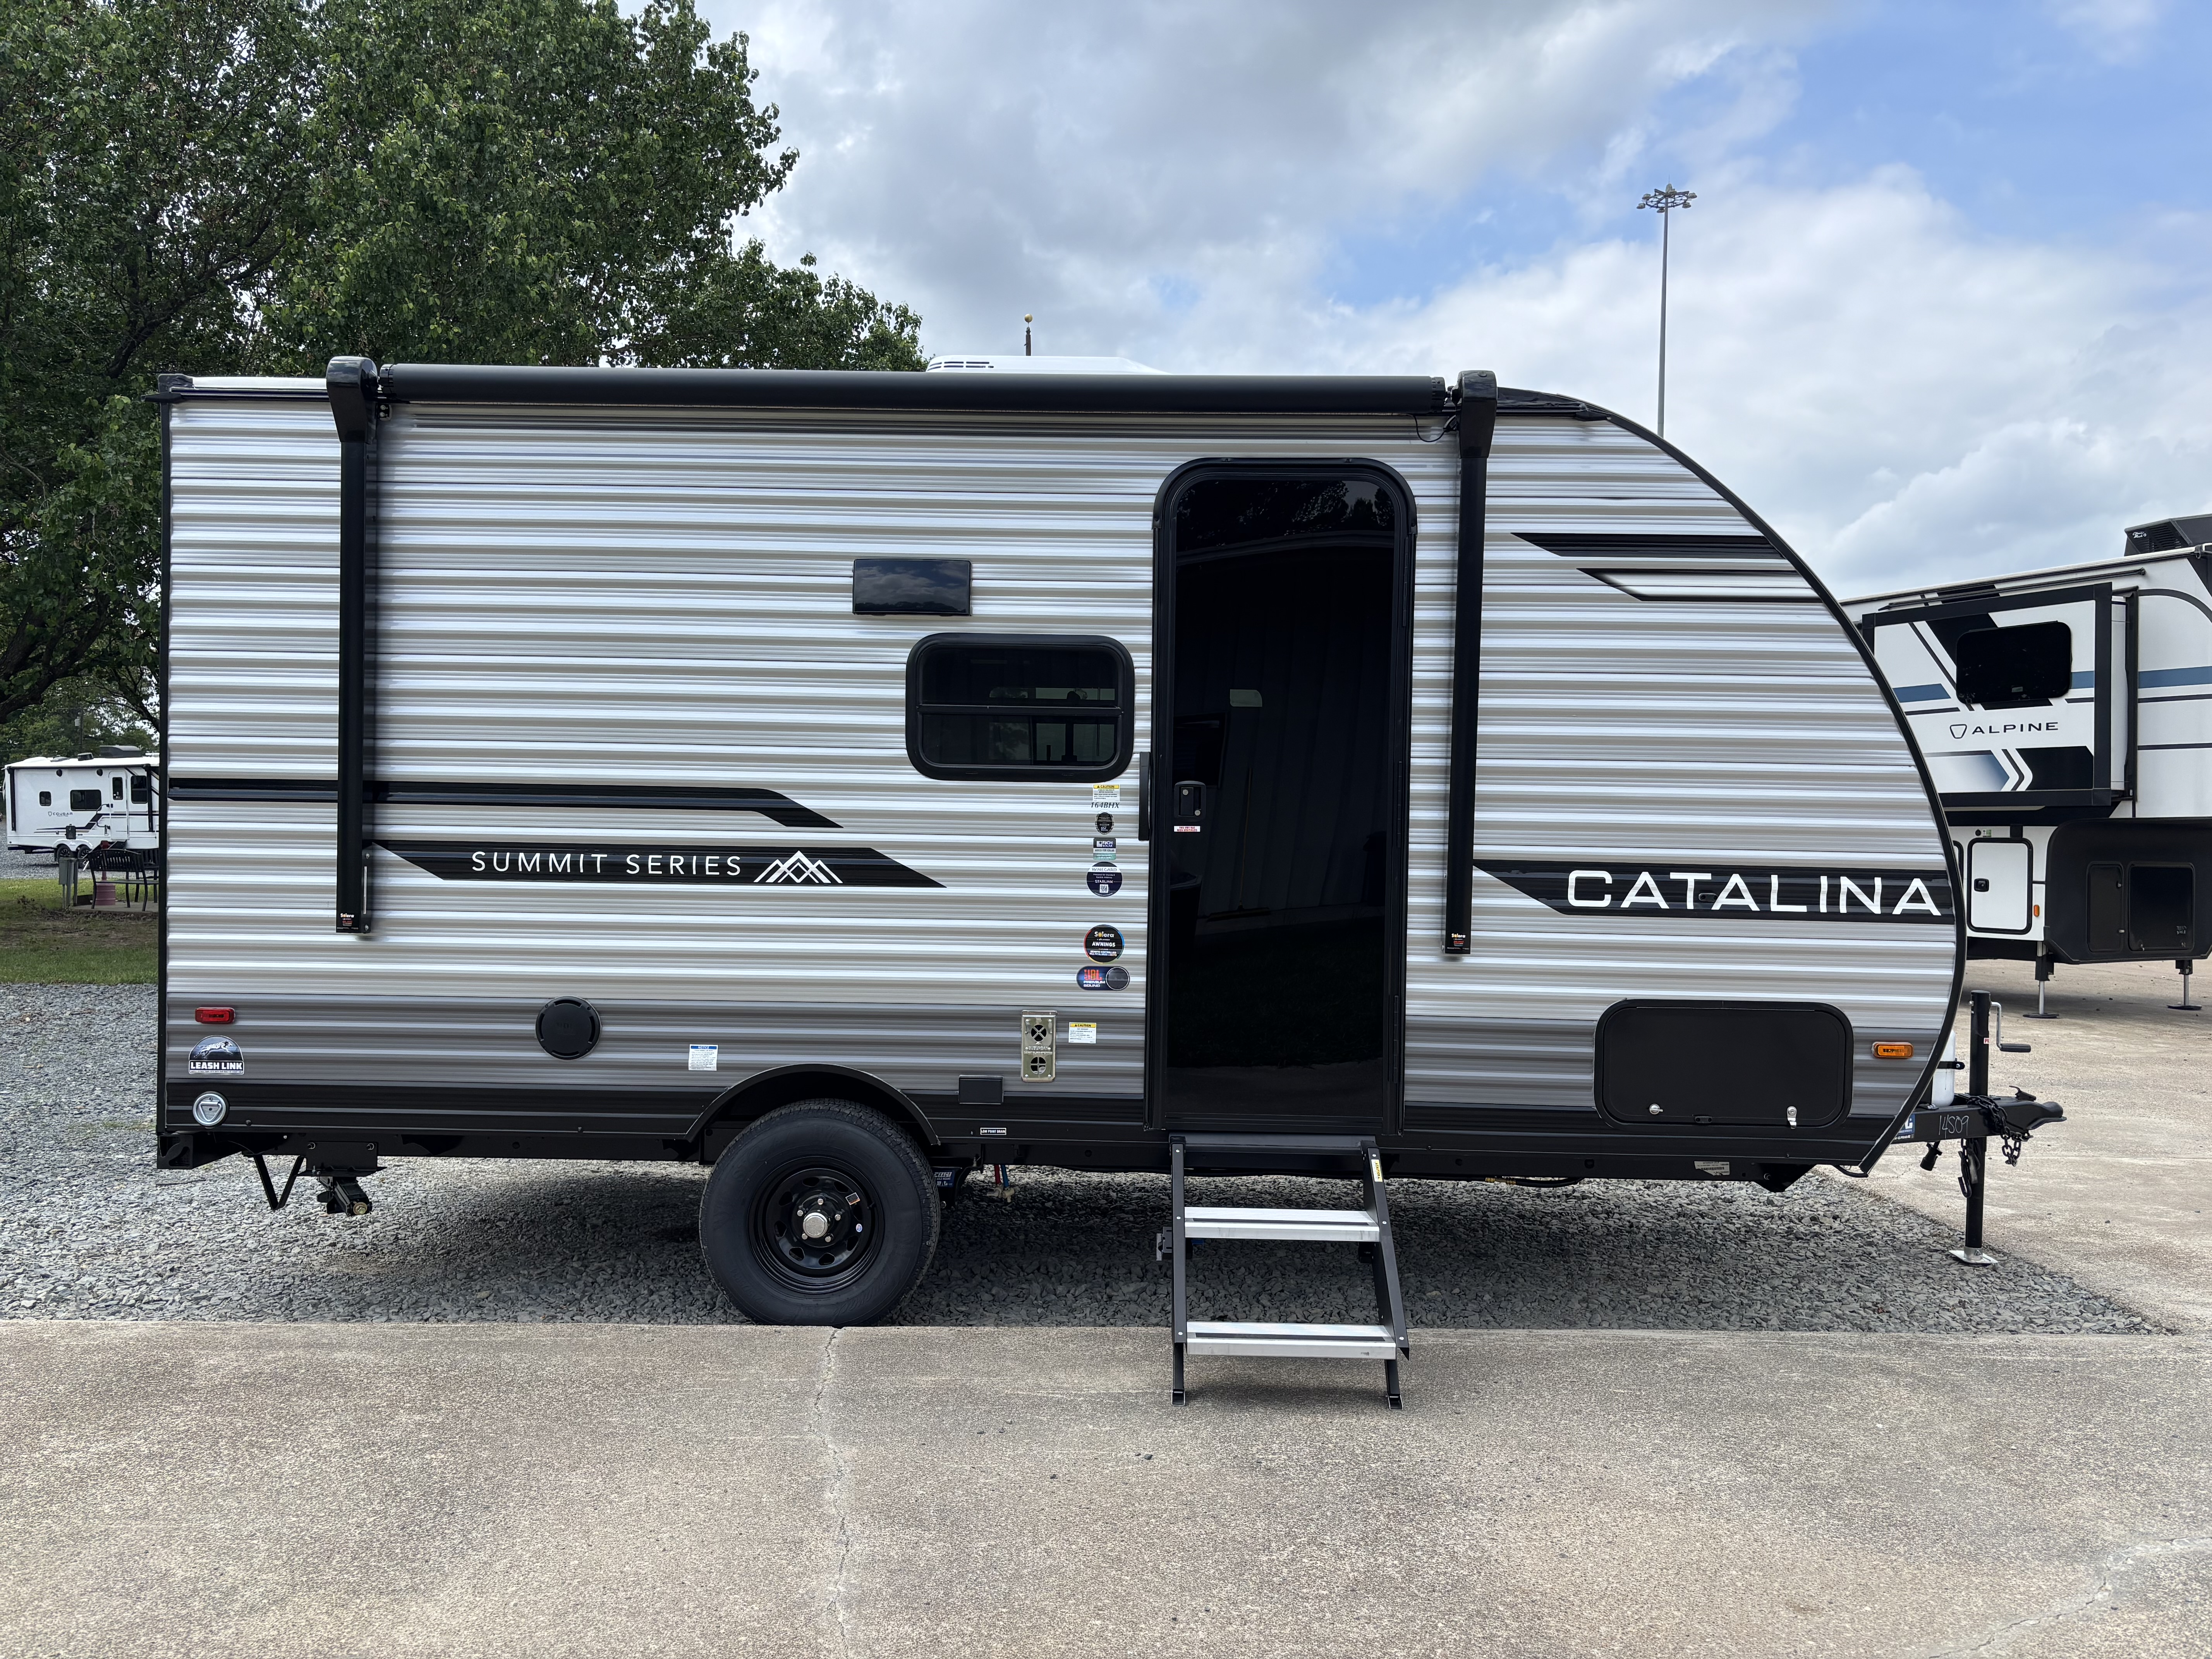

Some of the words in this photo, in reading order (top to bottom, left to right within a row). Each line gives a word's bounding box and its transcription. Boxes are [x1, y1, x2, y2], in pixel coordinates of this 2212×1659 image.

[1972, 722, 2058, 735] ALPINE
[472, 851, 608, 873] SUMMIT
[626, 854, 740, 876] SERIES
[1567, 870, 1942, 916] CATALINA
[1084, 969, 1103, 981] JBL
